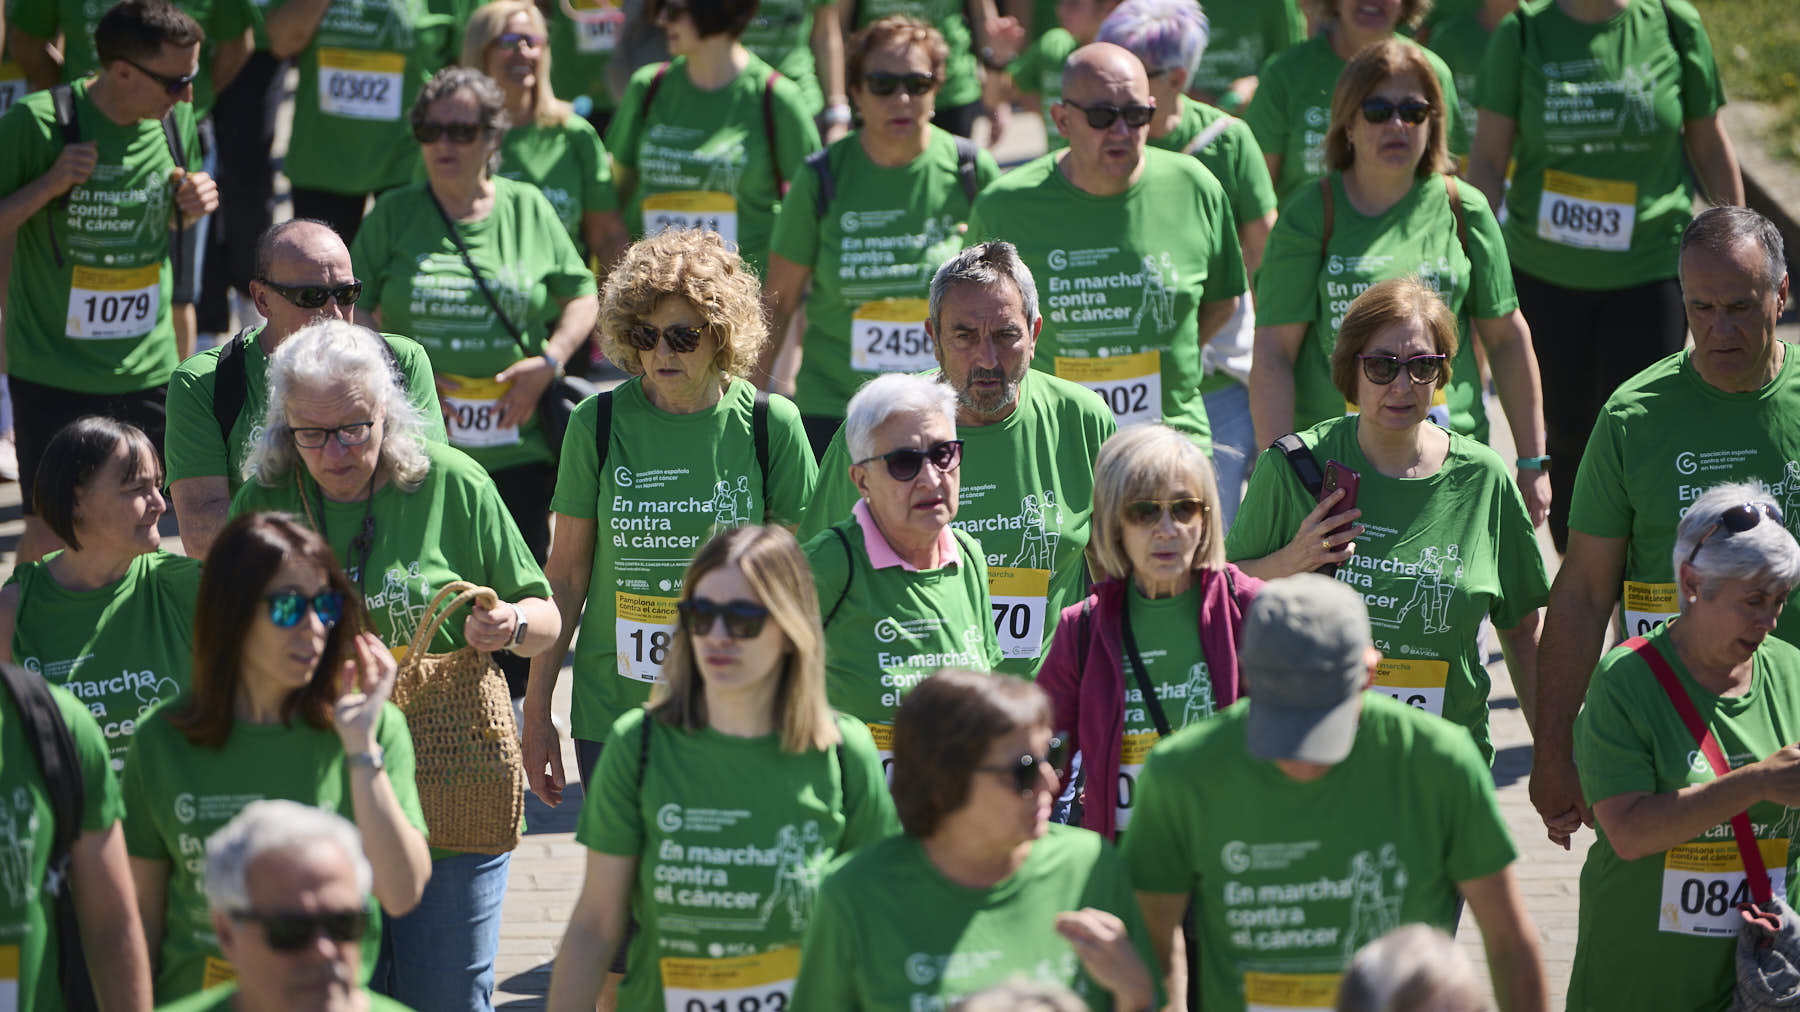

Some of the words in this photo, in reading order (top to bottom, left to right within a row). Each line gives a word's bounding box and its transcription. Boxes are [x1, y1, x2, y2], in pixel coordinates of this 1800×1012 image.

[328, 72, 391, 103] 0302
[68, 202, 119, 217] contra
[1552, 200, 1621, 235] 0893
[84, 216, 137, 232] cáncer
[1048, 277, 1071, 292] En
[1074, 271, 1143, 290] marcha
[84, 292, 150, 324] 1079
[1047, 291, 1107, 308] contra
[1050, 307, 1069, 322] el
[1070, 305, 1132, 322] cáncer
[1678, 483, 1703, 501] En
[611, 495, 633, 513] En
[637, 497, 714, 514] marcha
[610, 515, 672, 531] contra
[612, 533, 627, 548] el
[631, 532, 700, 549] cáncer
[1334, 568, 1373, 588] ntra
[619, 594, 656, 607] Pamplona
[619, 603, 641, 612] contra
[878, 652, 905, 669] En
[907, 648, 970, 668] marcha
[881, 689, 902, 707] el
[659, 839, 684, 861] En
[687, 844, 778, 866] marcha
[654, 864, 729, 887] contra
[653, 885, 674, 904] el
[676, 887, 761, 909] cáncer
[1256, 876, 1354, 903] marcha
[1681, 878, 1772, 917] 084
[1224, 904, 1306, 928] contra
